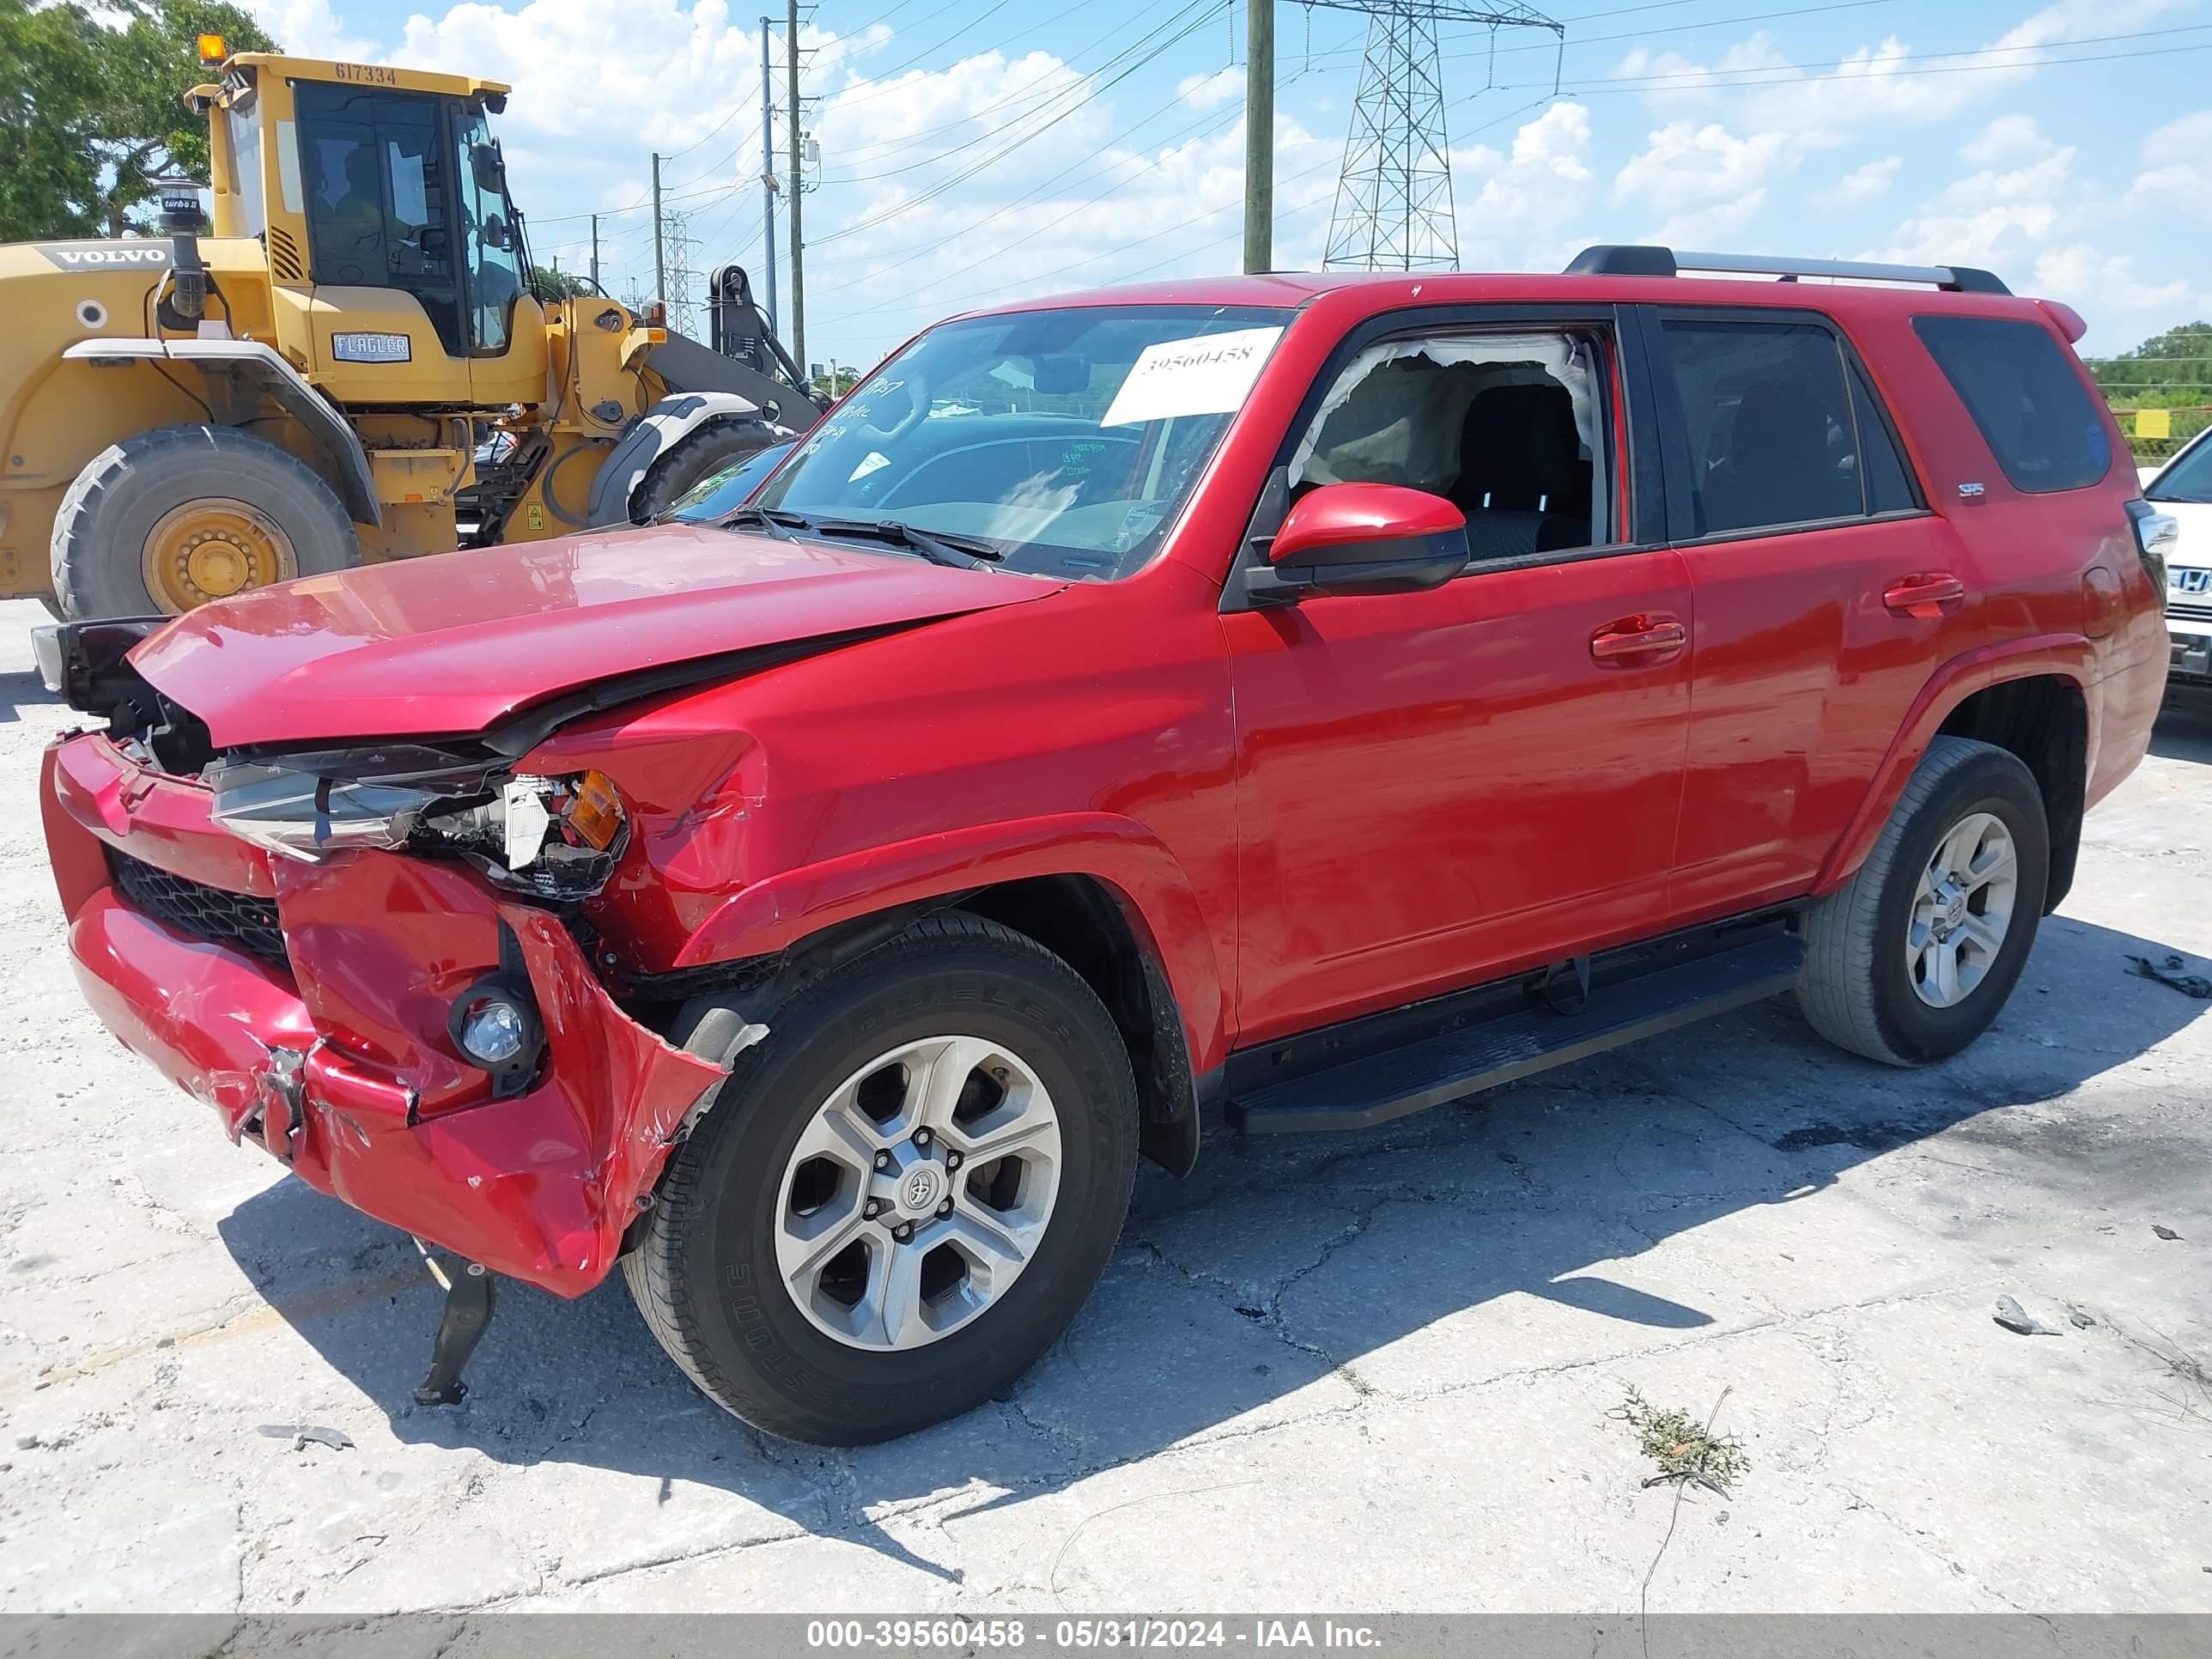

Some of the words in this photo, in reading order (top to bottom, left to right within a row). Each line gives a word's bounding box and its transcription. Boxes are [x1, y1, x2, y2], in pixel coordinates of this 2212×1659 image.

[336, 63, 396, 85] 617334
[165, 199, 189, 209] turbo
[57, 249, 166, 264] VOLVO
[336, 336, 408, 354] FLAGLER
[1141, 346, 1254, 375] 39560458
